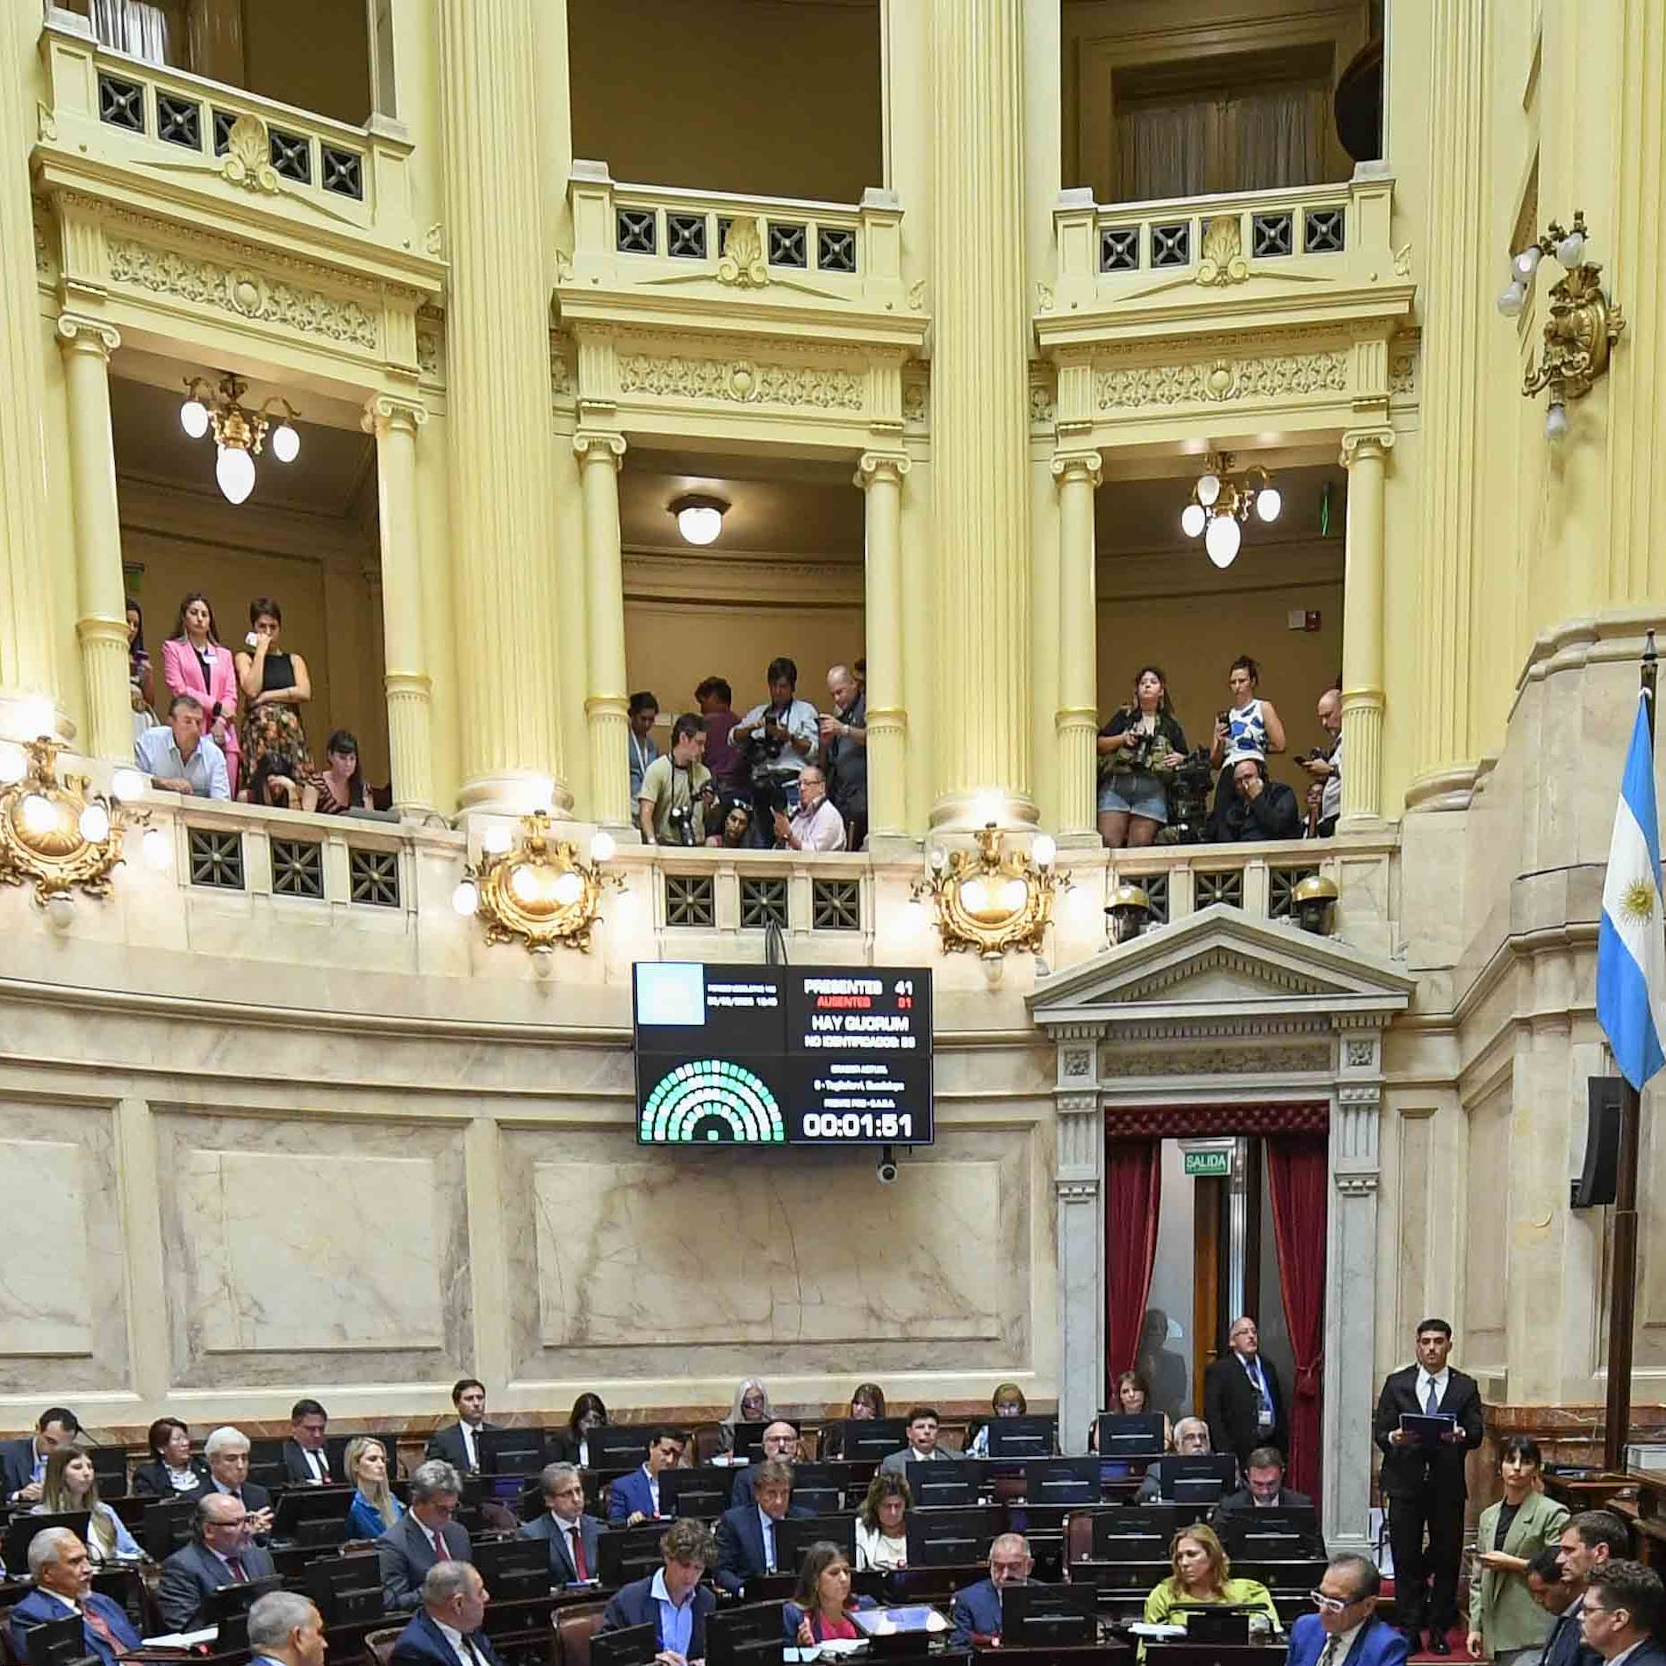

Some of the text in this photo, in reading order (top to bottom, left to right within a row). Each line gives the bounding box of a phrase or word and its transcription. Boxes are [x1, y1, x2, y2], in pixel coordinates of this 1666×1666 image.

[894, 980, 913, 996] 41
[812, 1015, 909, 1032] HAY QUORUM
[803, 1113, 912, 1138] 00:01:51
[1186, 1155, 1226, 1168] SALIDA
